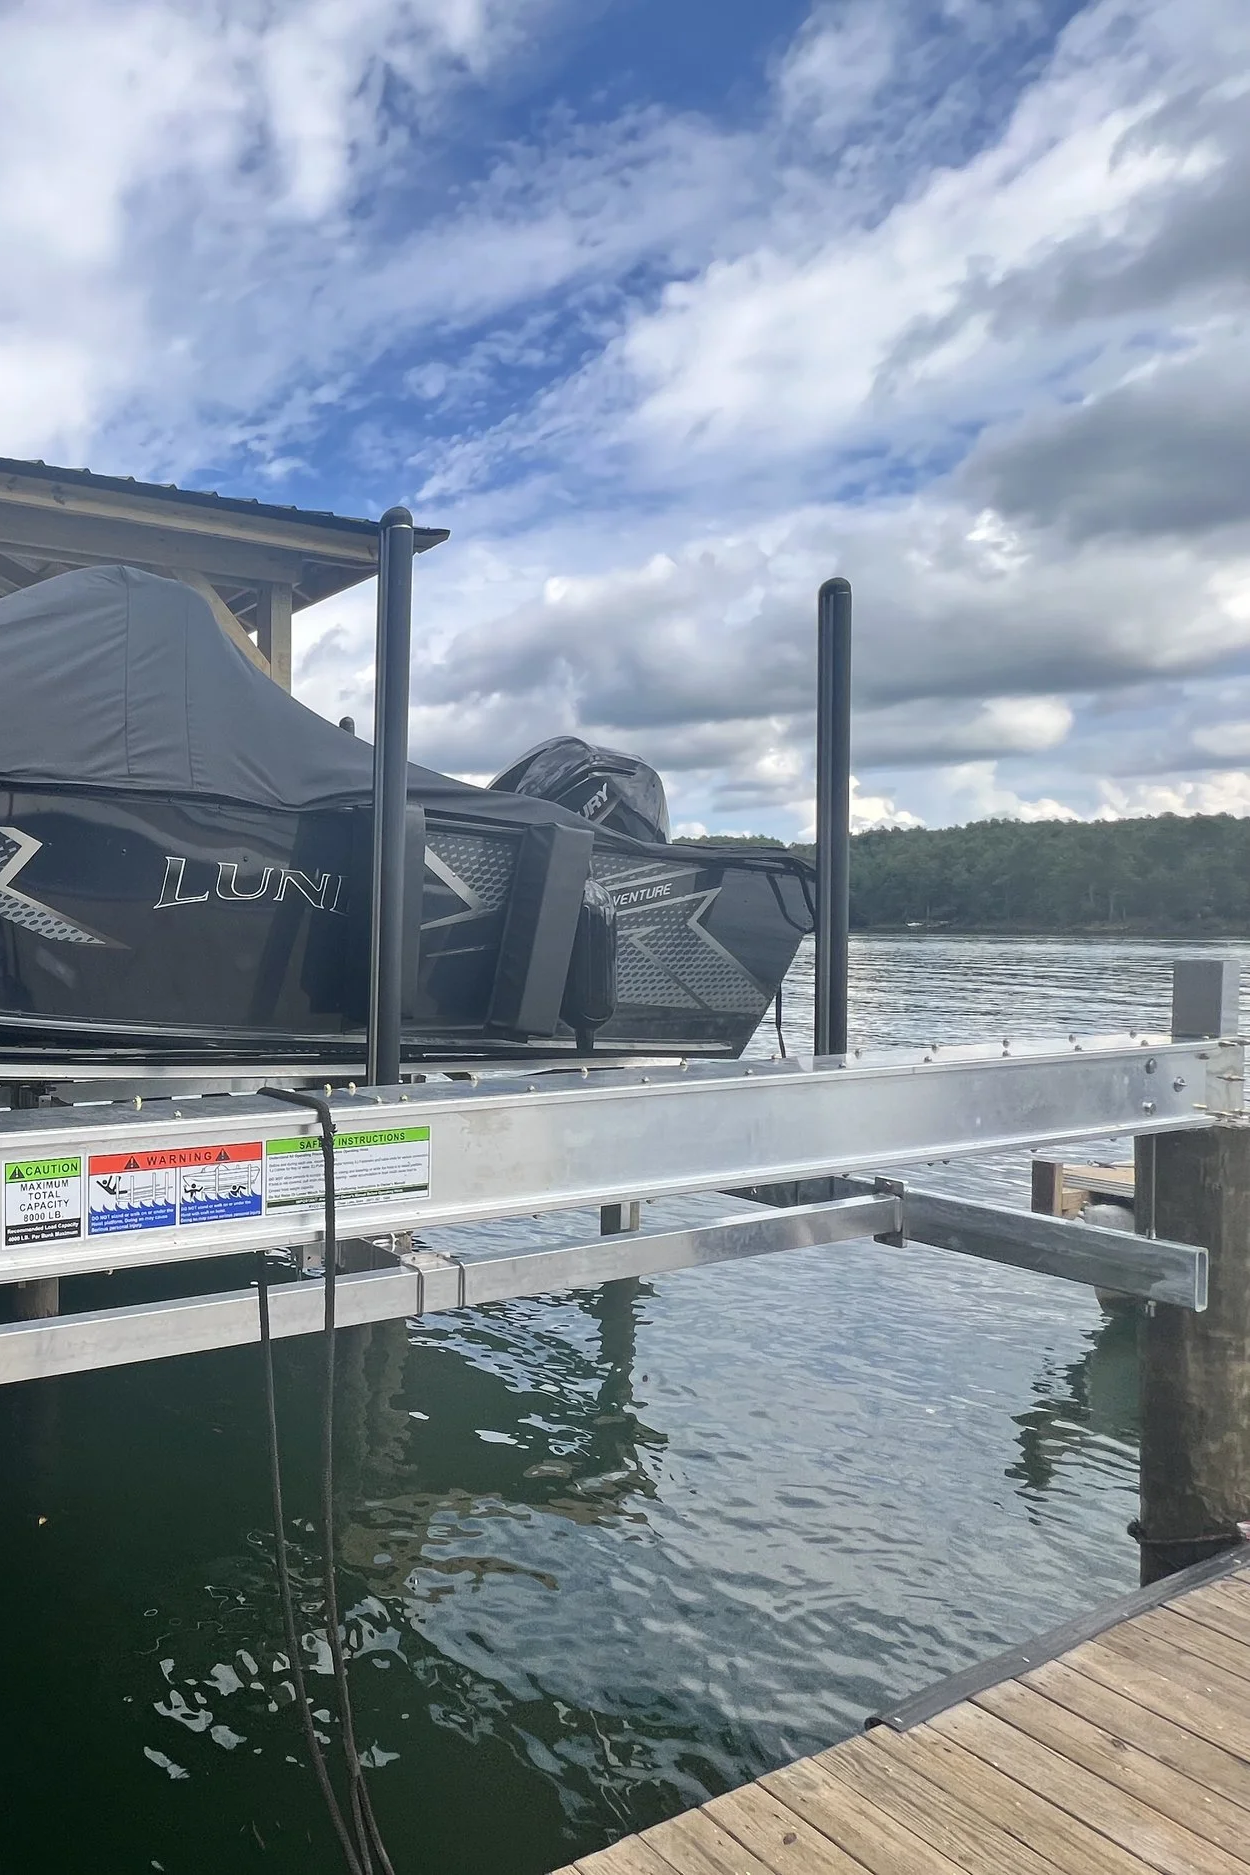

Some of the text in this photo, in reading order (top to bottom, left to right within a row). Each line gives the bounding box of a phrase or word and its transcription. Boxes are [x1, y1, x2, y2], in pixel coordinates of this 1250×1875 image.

[613, 883, 672, 906] VENTURE
[299, 1132, 405, 1150] SAFE INSTRUCTIONS
[146, 1151, 212, 1166] WARNING
[25, 1162, 78, 1176] CAUTION
[20, 1179, 69, 1191] MAXIMUM
[28, 1191, 61, 1200] TOTAL
[19, 1199, 70, 1212] CAPACITY
[23, 1211, 64, 1222] 8000 LB.
[7, 1224, 44, 1235] Recommended
[45, 1223, 57, 1231] Load
